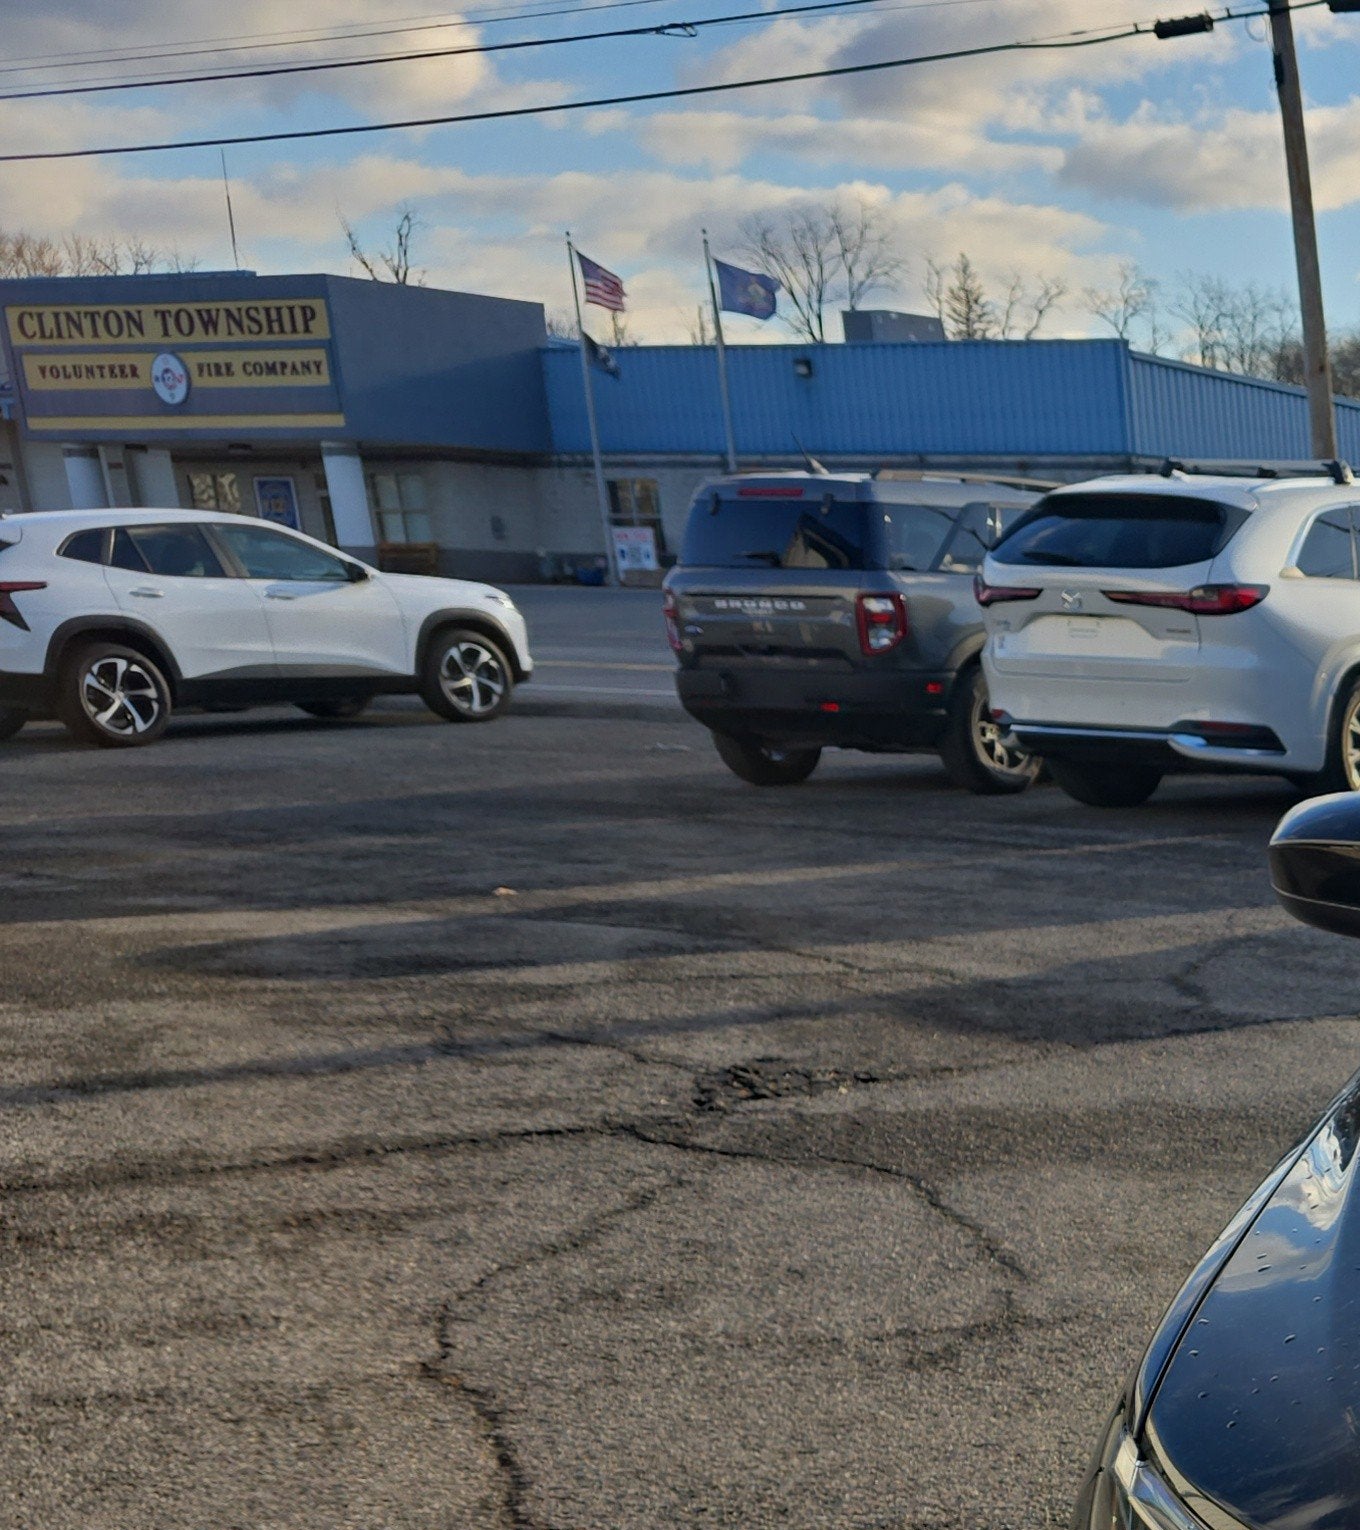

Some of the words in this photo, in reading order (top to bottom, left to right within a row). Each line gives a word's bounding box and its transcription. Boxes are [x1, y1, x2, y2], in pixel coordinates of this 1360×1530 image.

[17, 309, 145, 339] CLINTON
[154, 304, 317, 337] TOWNSHIP
[38, 364, 140, 380] VOLUNTEER
[197, 362, 235, 378] FIRE
[242, 359, 323, 377] COMPANY
